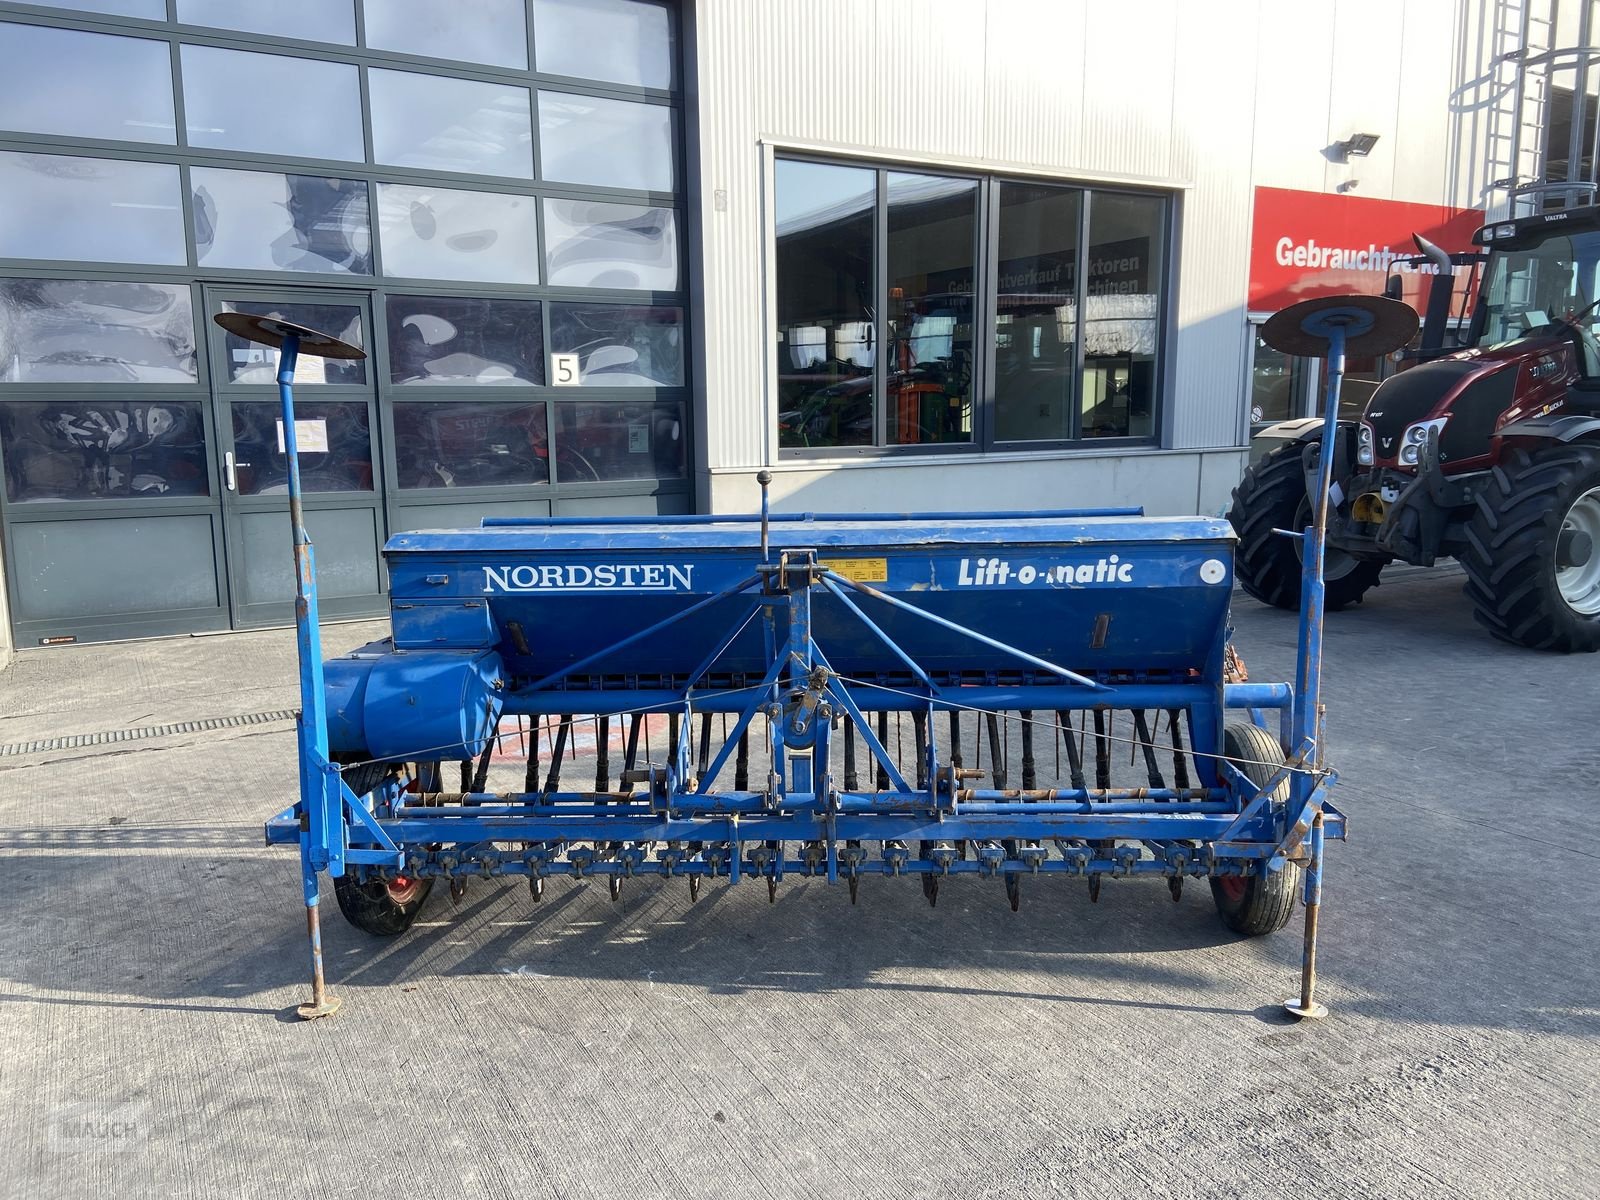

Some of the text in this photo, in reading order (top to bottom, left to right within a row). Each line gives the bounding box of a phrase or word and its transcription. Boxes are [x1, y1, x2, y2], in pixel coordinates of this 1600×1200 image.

[1544, 213, 1568, 222] VALTRA
[1065, 256, 1139, 280] Tktoren
[1275, 237, 1463, 275] Gebrauchtve
[558, 358, 572, 382] 5
[482, 564, 694, 592] NORDSTEN
[958, 554, 1134, 586] Lift-o-matic
